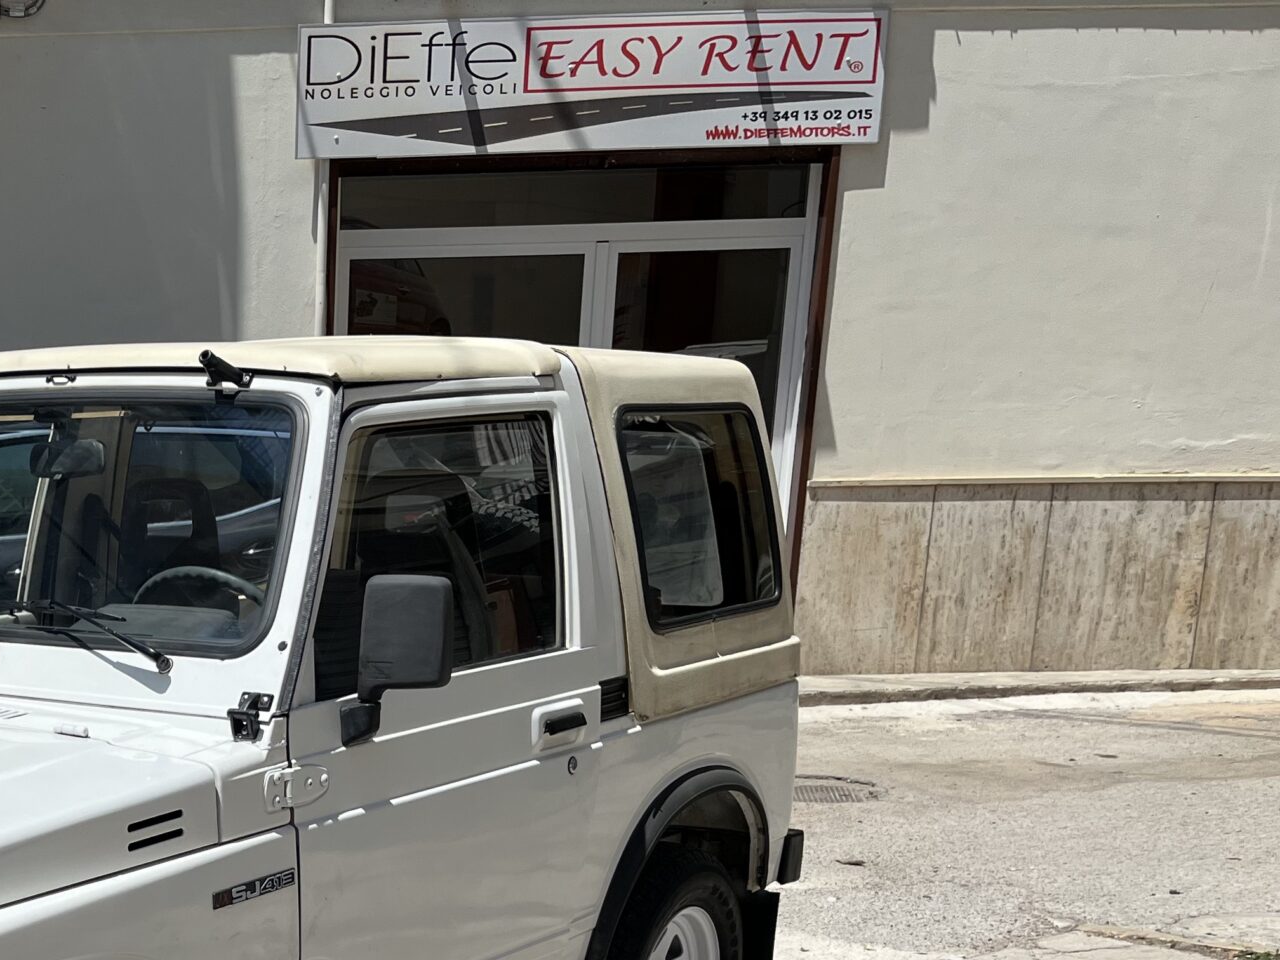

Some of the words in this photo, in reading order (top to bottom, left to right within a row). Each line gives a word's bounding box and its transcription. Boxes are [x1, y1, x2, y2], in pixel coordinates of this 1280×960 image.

[306, 30, 517, 86] DiEffe
[536, 35, 684, 79] EASY
[304, 85, 416, 101] NOLEGGIO
[429, 82, 518, 97] VEICOLI
[741, 110, 768, 122] +39
[772, 109, 799, 122] 349
[803, 109, 819, 121] 13
[823, 109, 842, 121] 02
[847, 108, 873, 120] 015
